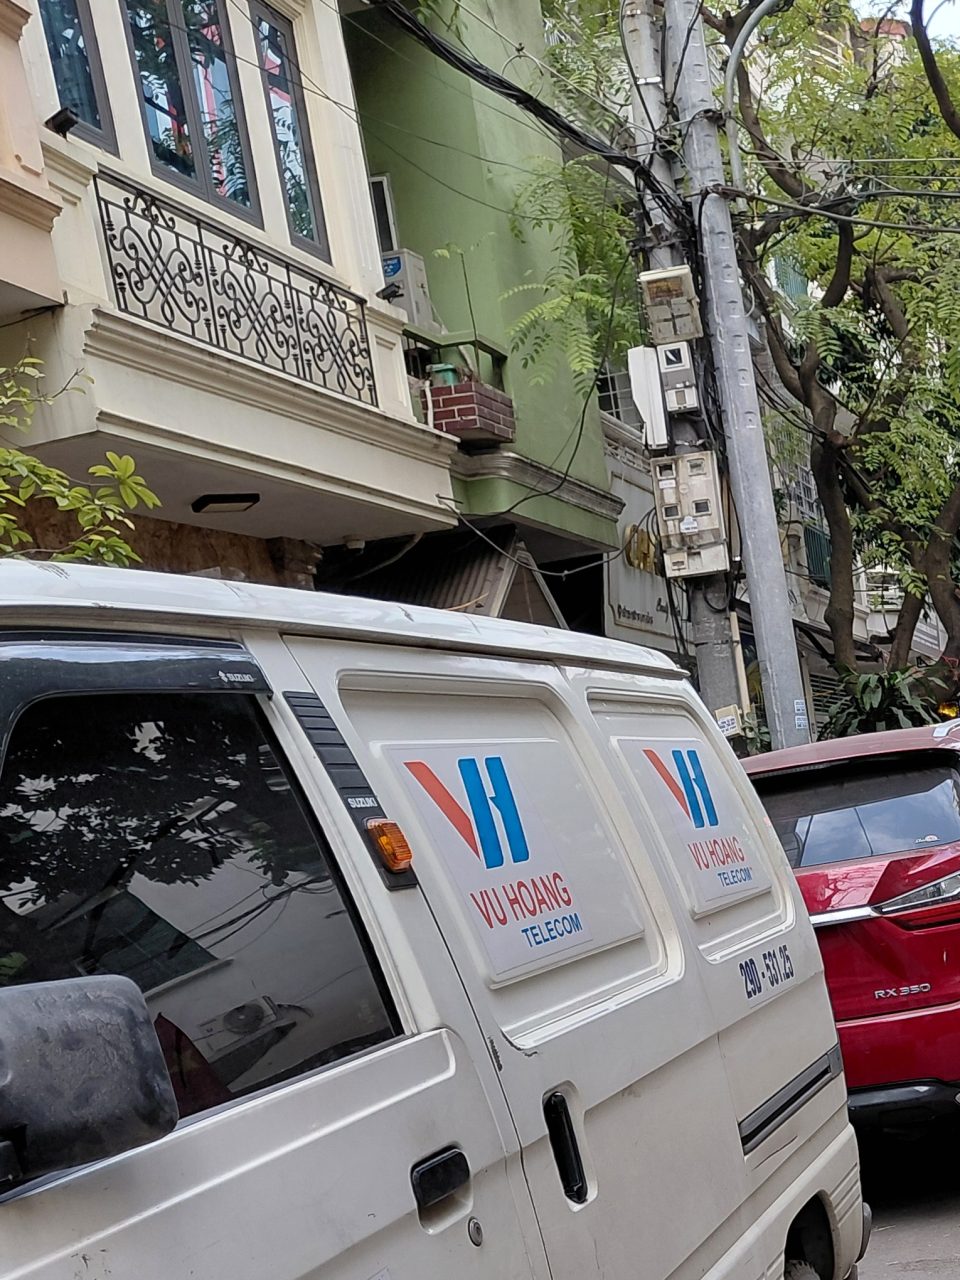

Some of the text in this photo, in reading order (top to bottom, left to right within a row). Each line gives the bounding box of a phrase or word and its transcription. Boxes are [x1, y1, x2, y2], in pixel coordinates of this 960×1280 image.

[227, 673, 255, 682] SUZUKI
[348, 798, 377, 808] SUZUKI
[688, 836, 744, 871] VU HOANG
[718, 867, 752, 887] TELECOM
[470, 872, 572, 929] VU HOANG
[521, 913, 583, 948] TELECOM
[738, 957, 762, 999] 29D
[762, 945, 794, 988] 531.25
[874, 983, 931, 999] RX 350
